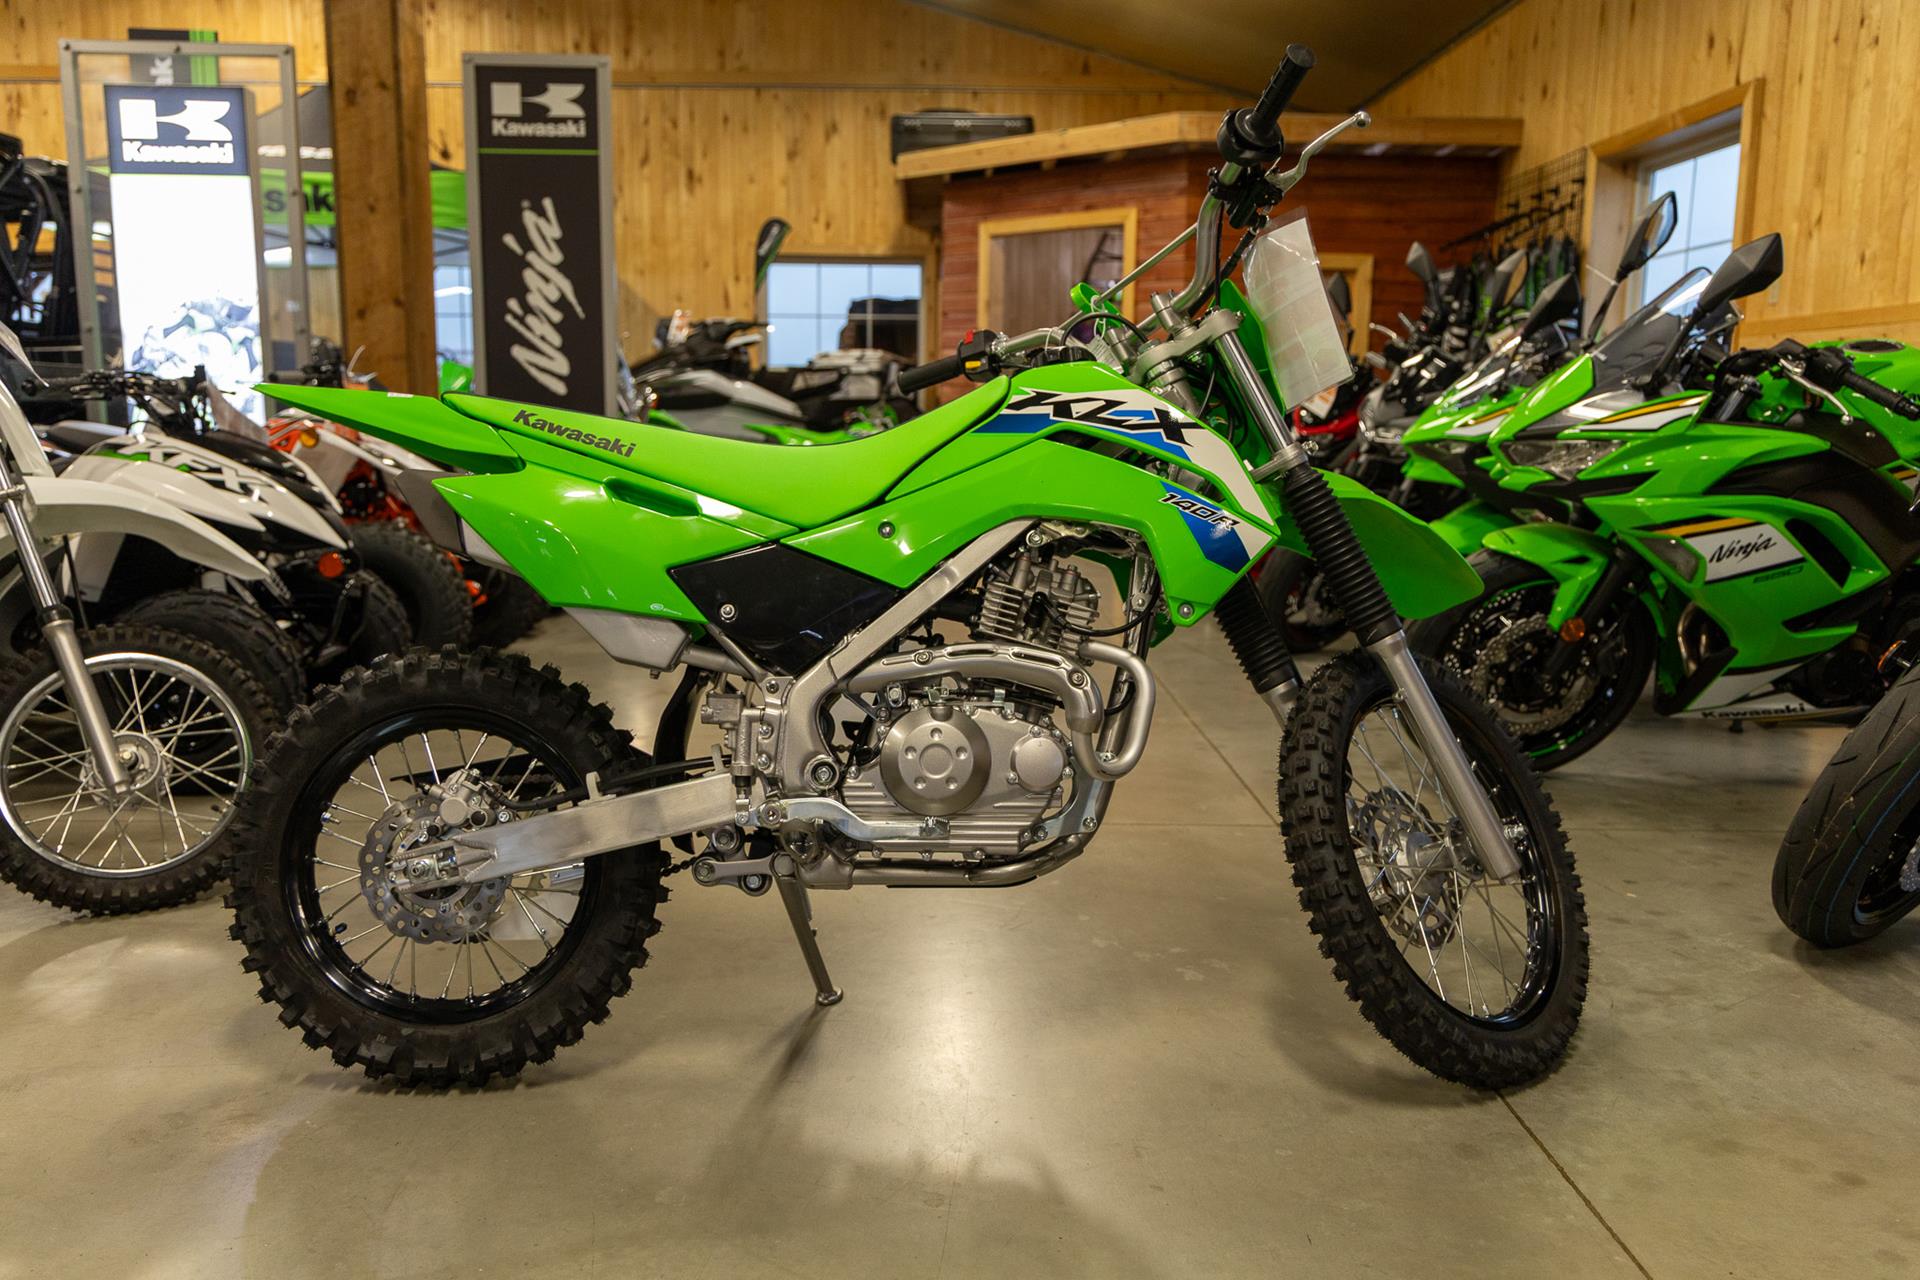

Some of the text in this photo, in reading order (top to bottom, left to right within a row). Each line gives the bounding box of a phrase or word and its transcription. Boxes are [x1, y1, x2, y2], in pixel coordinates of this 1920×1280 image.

[492, 118, 586, 137] Kawasaki
[502, 196, 585, 396] Ninja
[513, 409, 636, 458] Kawasaki
[1003, 390, 1207, 447] KLX
[1159, 493, 1241, 531] 140R
[1708, 533, 1777, 563] Ninja
[1701, 702, 1806, 718] Kawasaki
